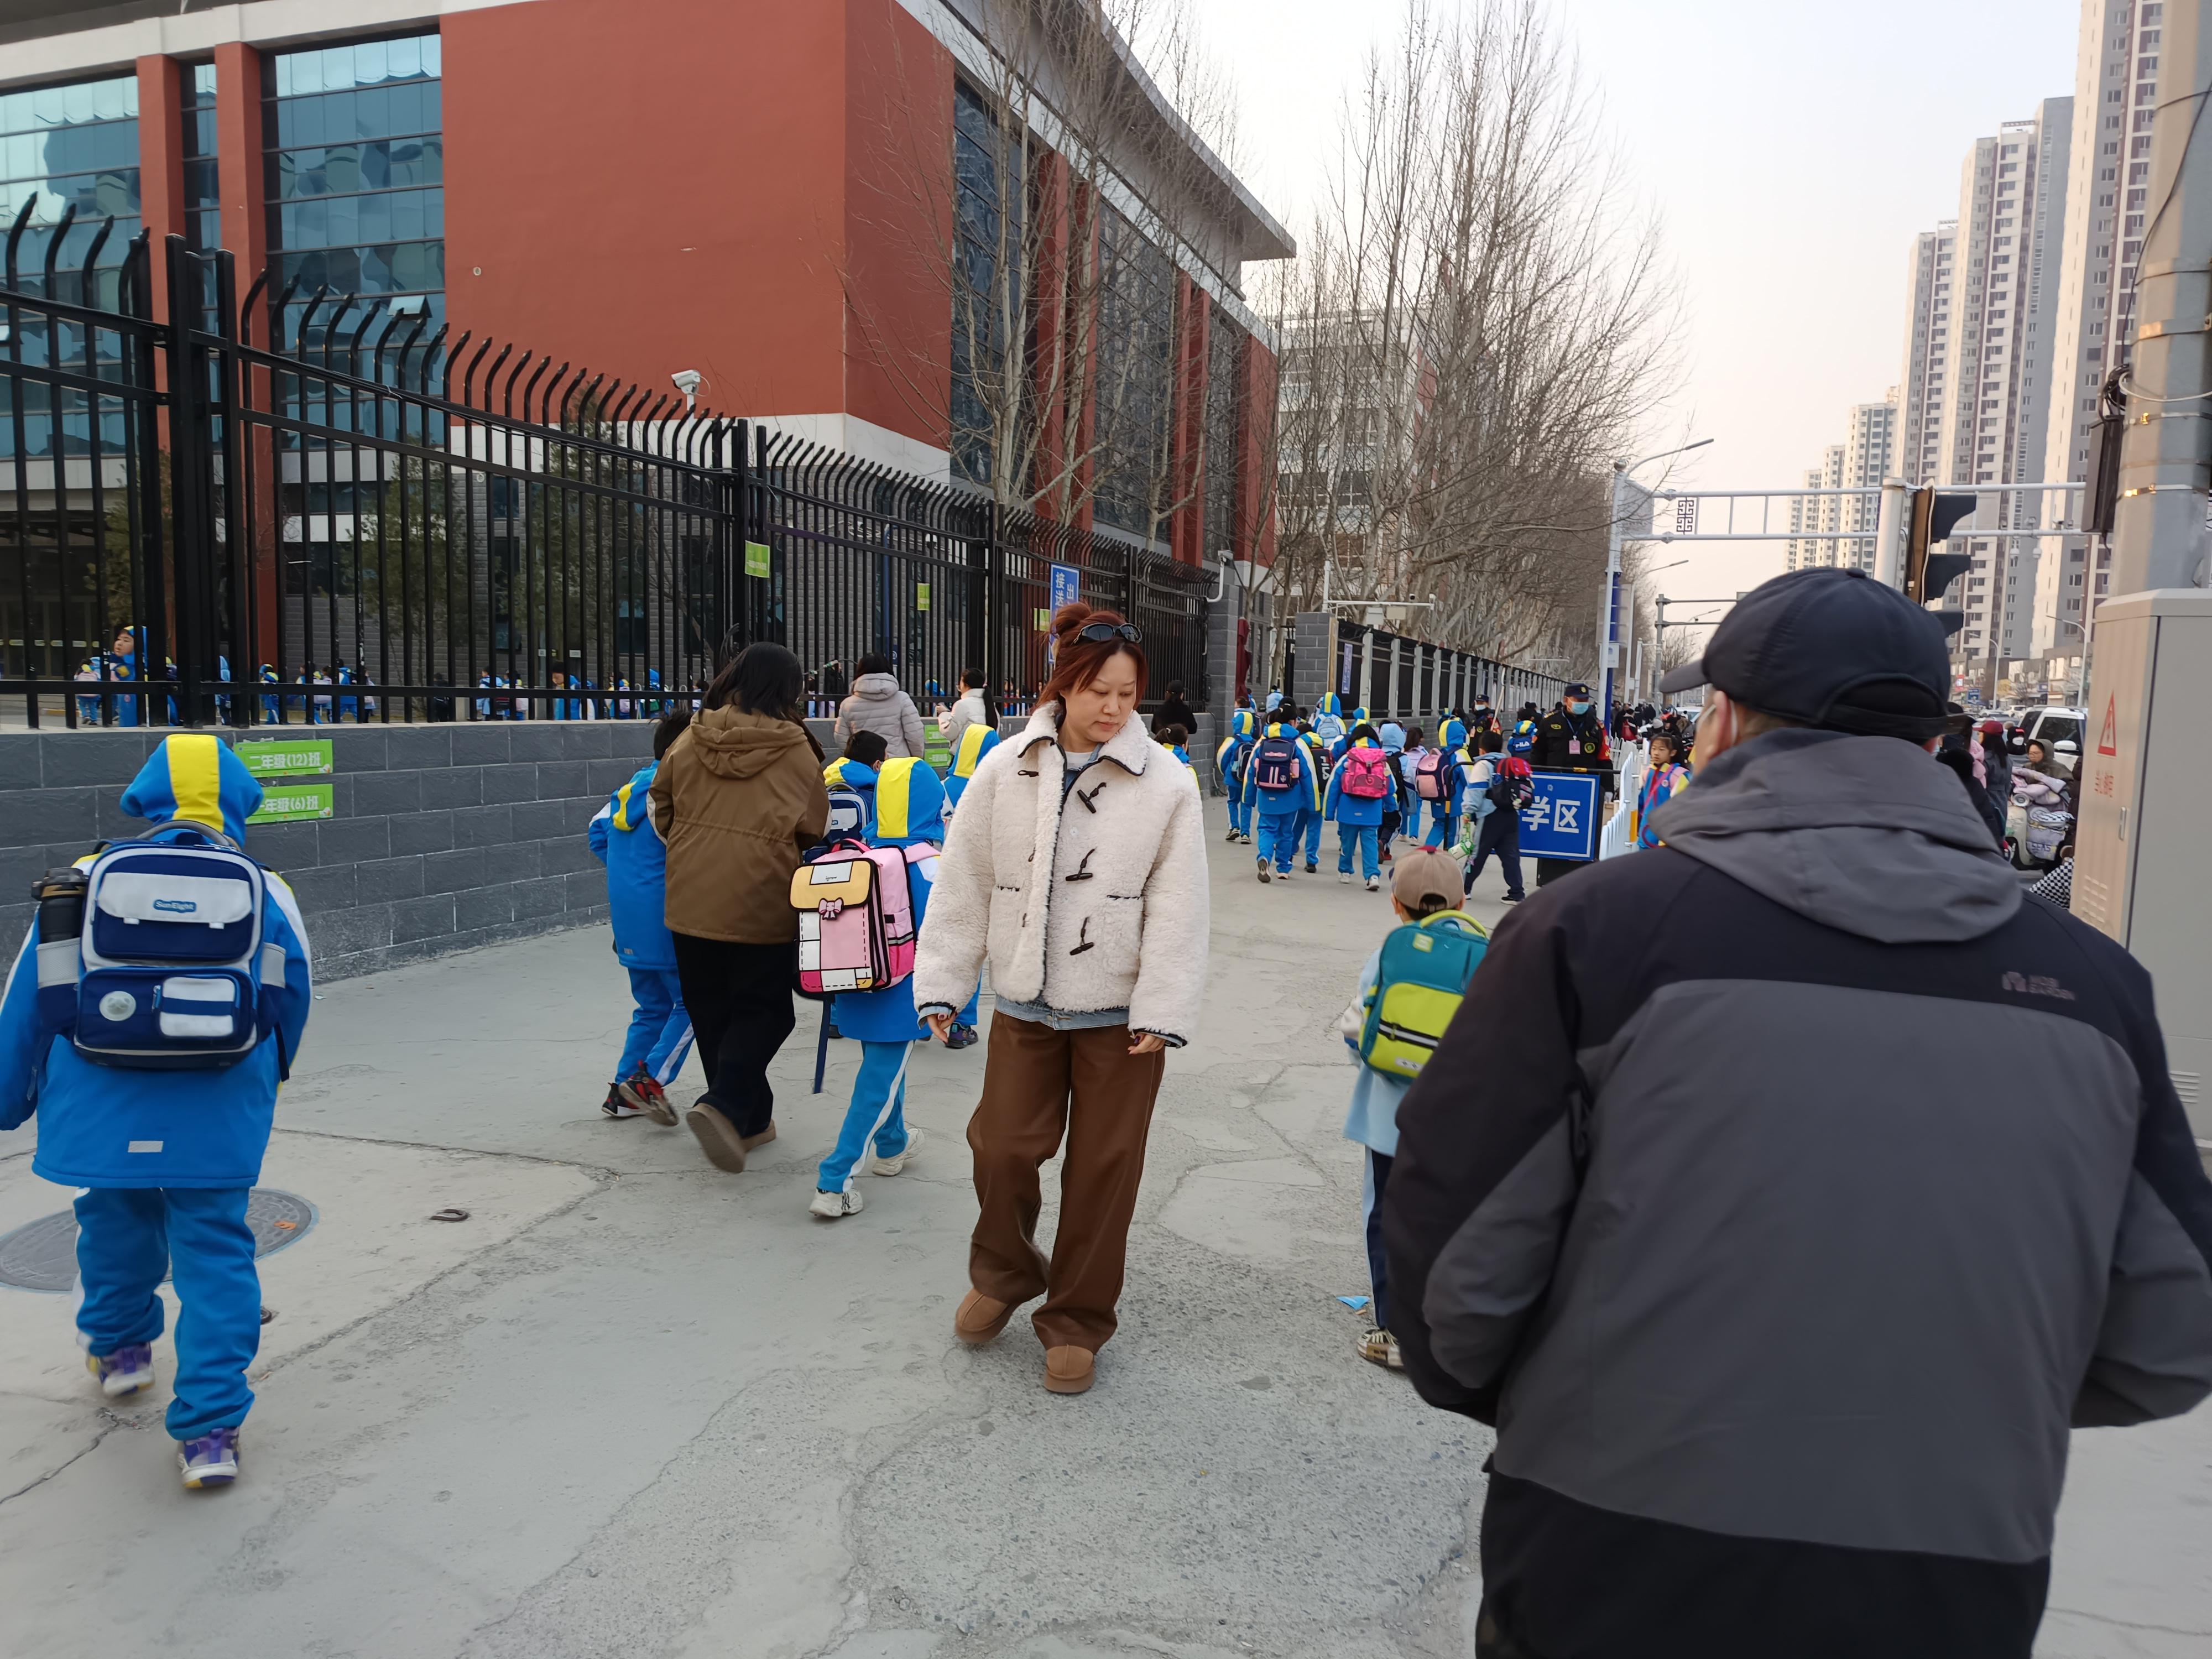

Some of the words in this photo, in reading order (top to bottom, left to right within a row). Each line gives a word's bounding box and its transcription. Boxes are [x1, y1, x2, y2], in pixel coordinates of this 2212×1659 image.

[1066, 583, 1074, 605] 出
[1320, 755, 1330, 780] FILA
[1521, 796, 1580, 833] 学区
